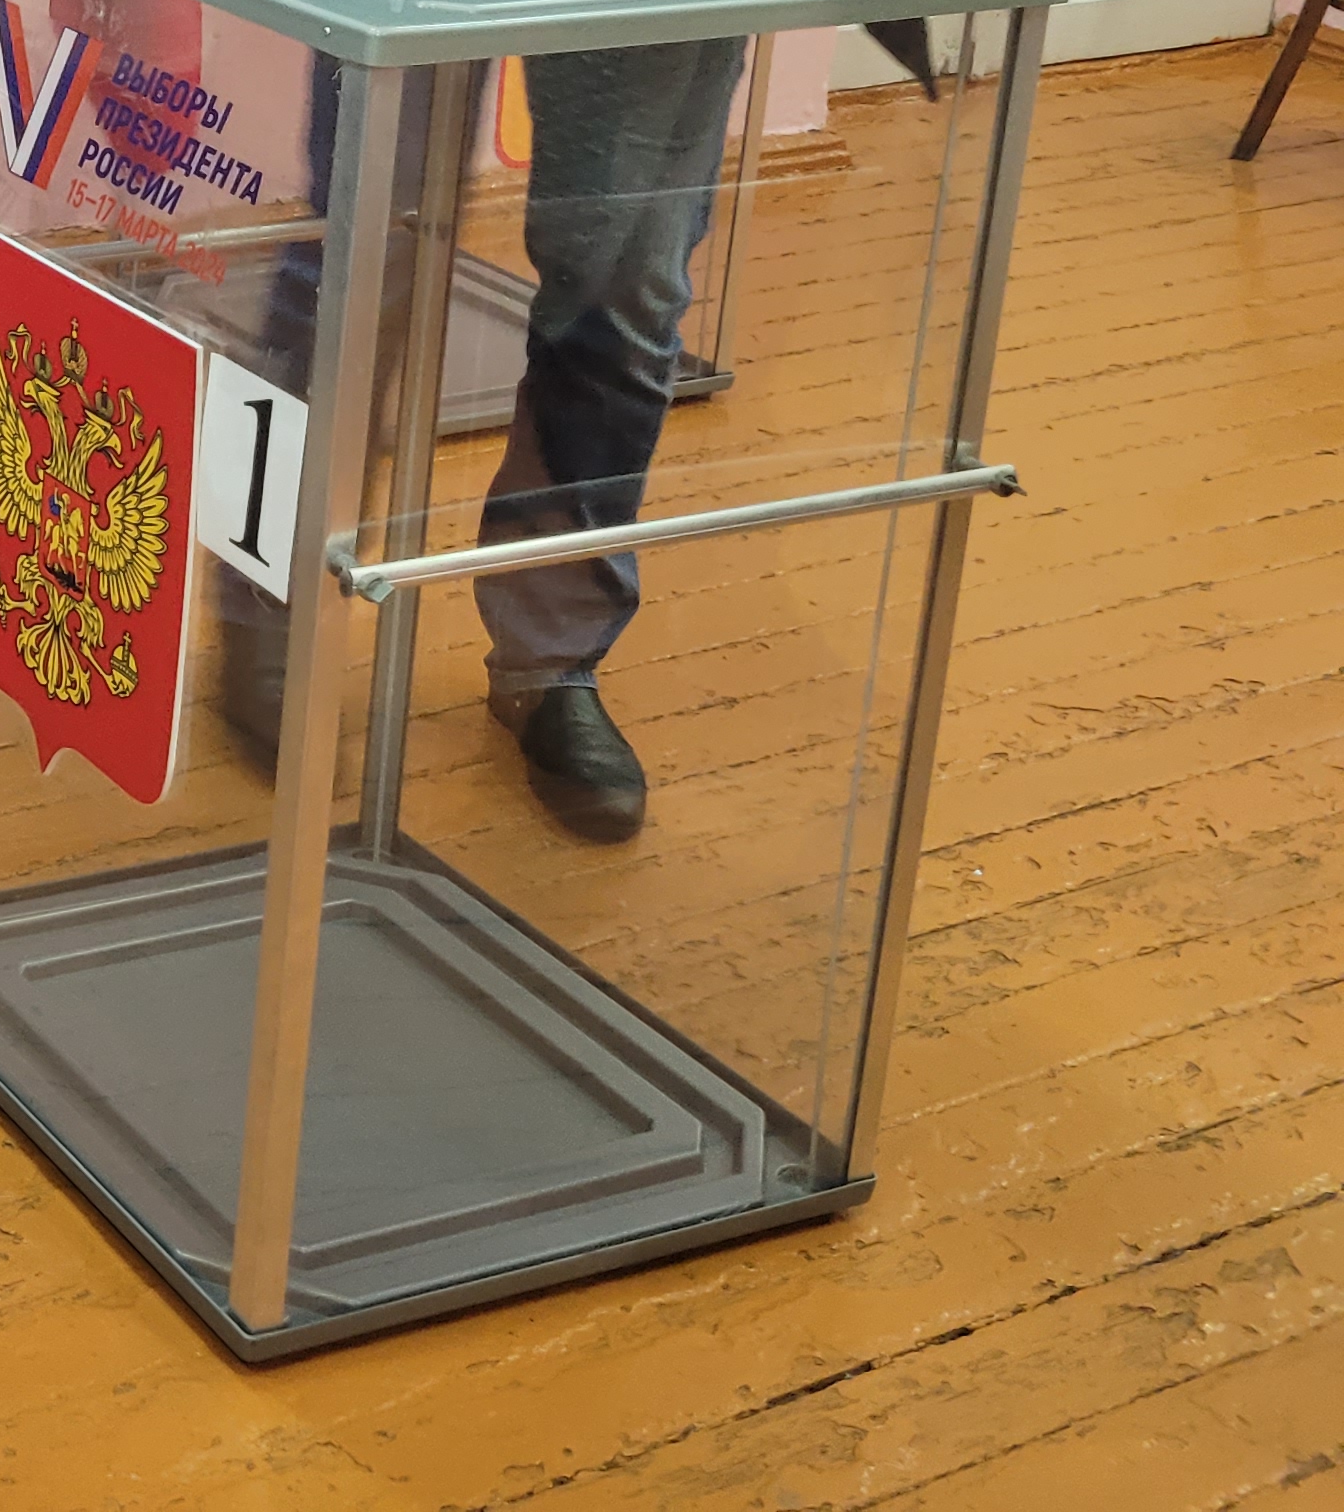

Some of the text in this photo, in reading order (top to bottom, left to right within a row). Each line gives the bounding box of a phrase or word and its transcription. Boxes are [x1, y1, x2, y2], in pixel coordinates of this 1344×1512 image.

[113, 53, 233, 134] ВЫБОРЫ
[78, 138, 184, 215] РОССИИ
[95, 97, 263, 205] ПРЕЗИДЕНТА
[114, 205, 180, 258] МАРТА
[178, 241, 228, 287] 2024
[228, 398, 274, 568] 1
